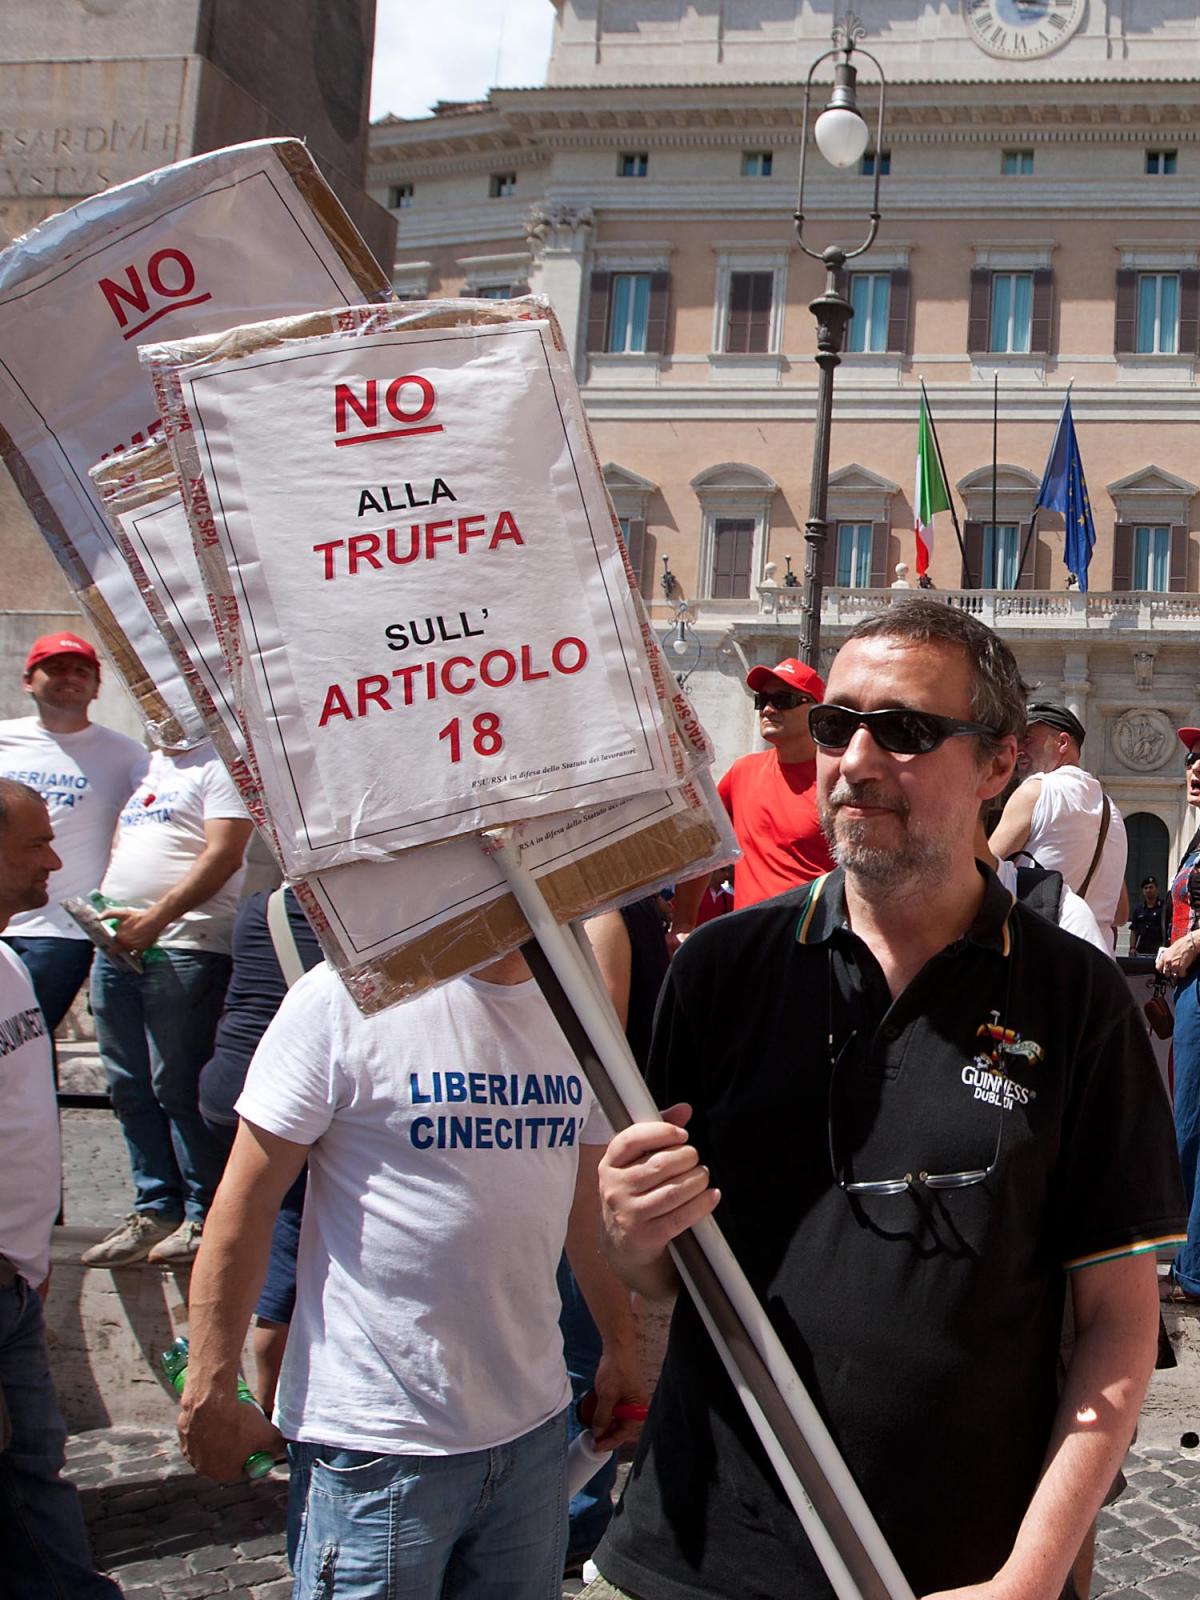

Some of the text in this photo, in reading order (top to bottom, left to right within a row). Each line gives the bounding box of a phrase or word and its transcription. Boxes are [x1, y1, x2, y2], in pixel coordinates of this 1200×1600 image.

[98, 247, 196, 327] NO
[335, 374, 436, 434] NO
[357, 478, 457, 517] ALLA
[313, 511, 524, 580] TRUFFA
[385, 608, 489, 651] SULL'
[318, 636, 589, 727] ARTICOLO
[672, 693, 691, 720] SPA
[438, 712, 503, 764] 18
[5, 770, 89, 790] BERIAMO
[519, 768, 541, 780] difesa
[542, 764, 560, 775] dello
[561, 760, 587, 770] Statuto
[588, 755, 600, 765] dei
[600, 748, 637, 762] lavoratori
[409, 1071, 583, 1106] LIBERIAMO
[961, 1066, 1030, 1104] GUINNESS
[973, 1087, 1014, 1110] DUBLIN
[409, 1115, 585, 1149] CINECITTA'
